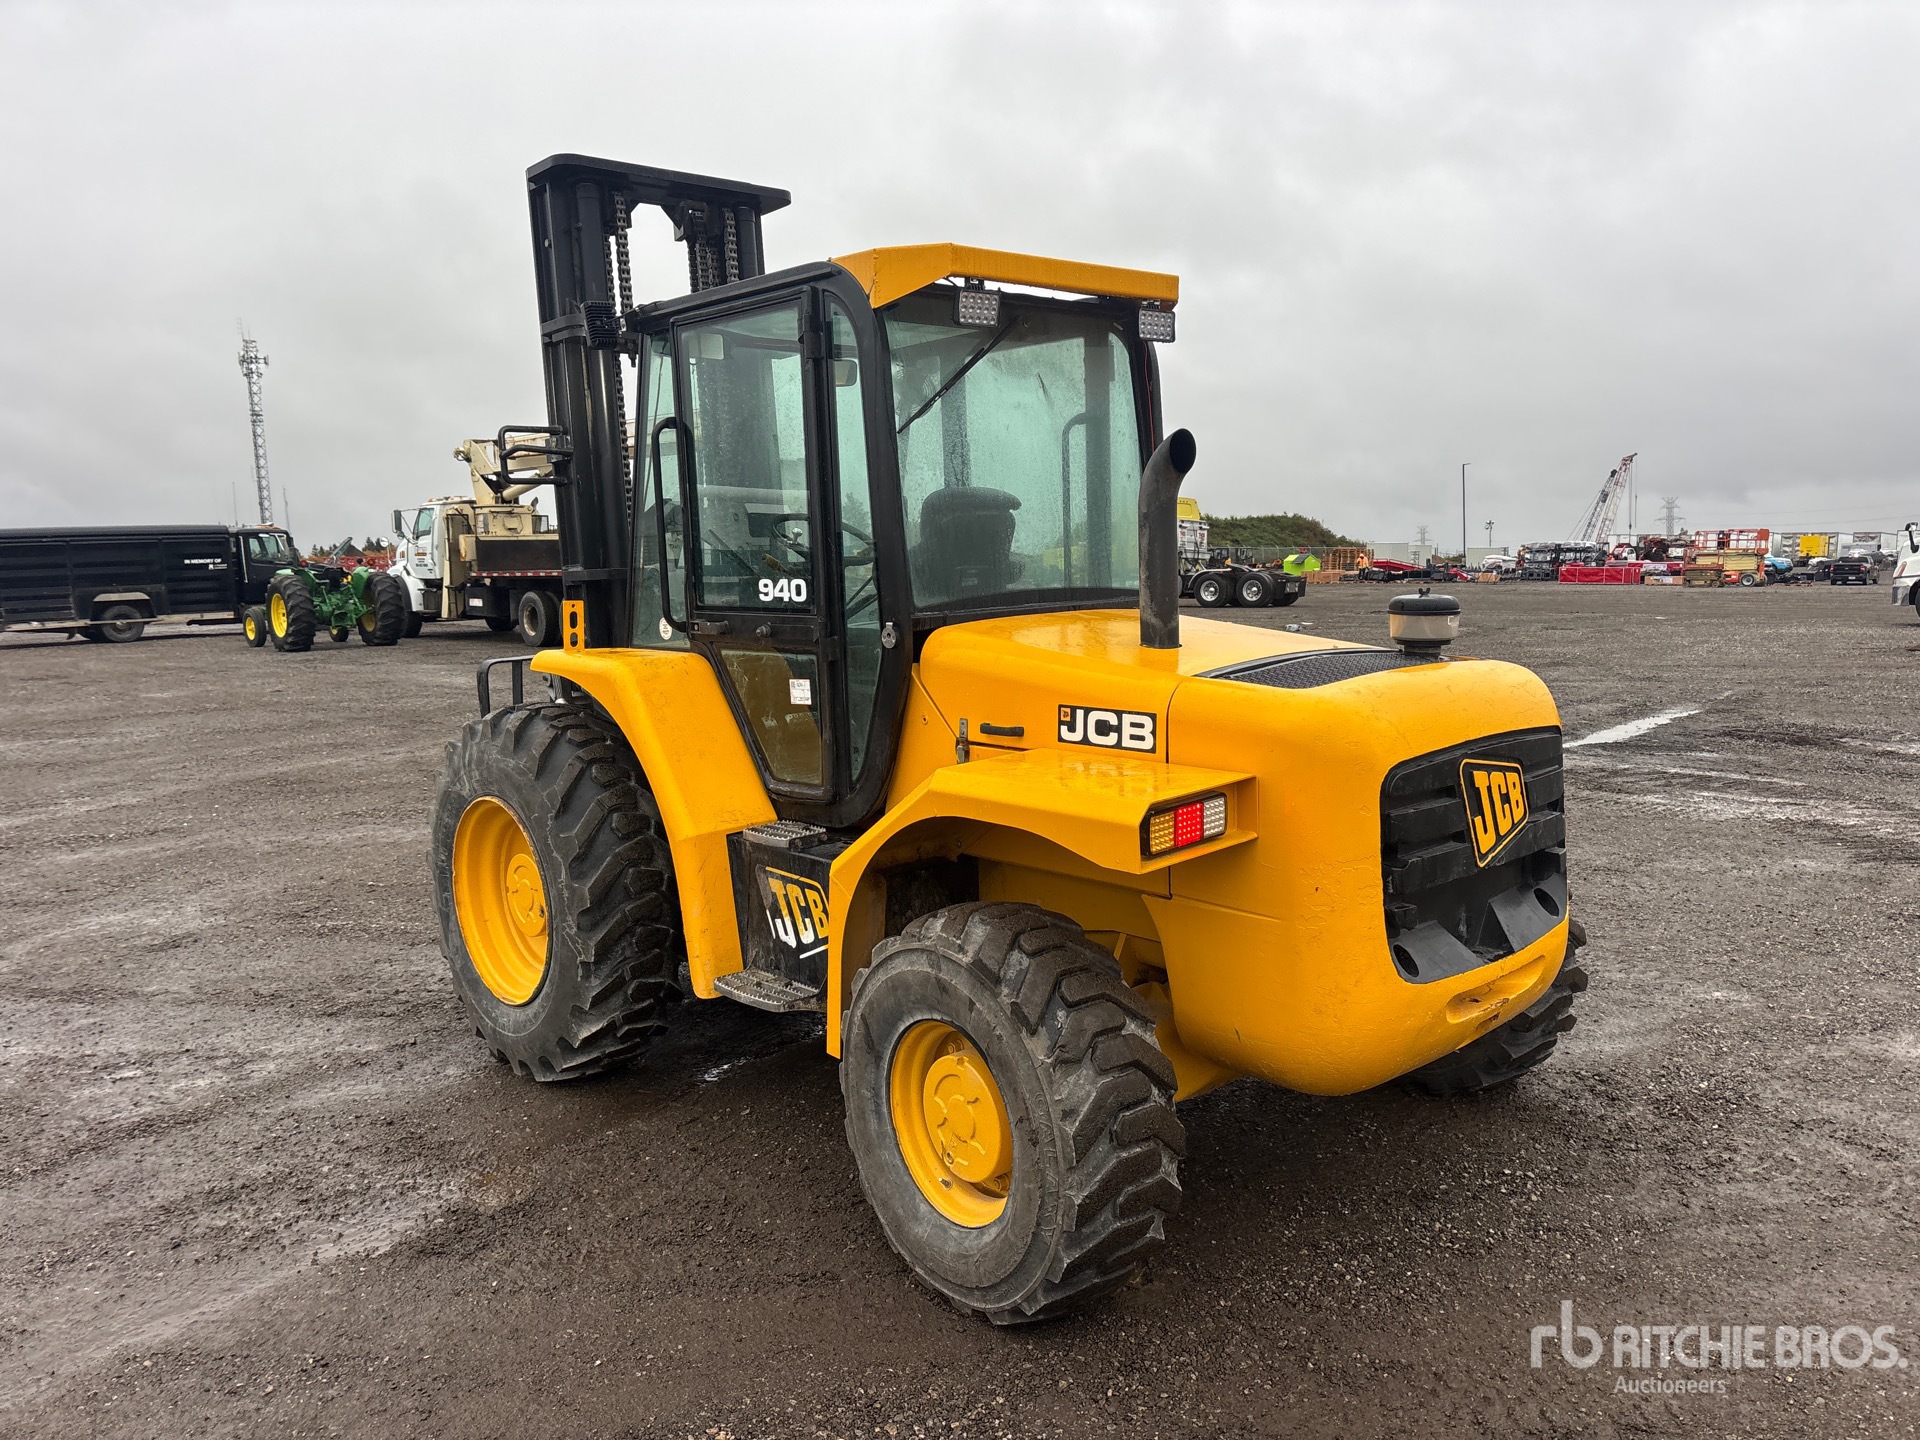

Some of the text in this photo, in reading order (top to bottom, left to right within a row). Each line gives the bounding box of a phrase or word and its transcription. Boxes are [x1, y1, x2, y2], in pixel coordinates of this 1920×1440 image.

[758, 578, 807, 602] 940
[1060, 708, 1154, 750] JCB
[1474, 771, 1525, 854] JCB
[767, 877, 829, 949] JCB
